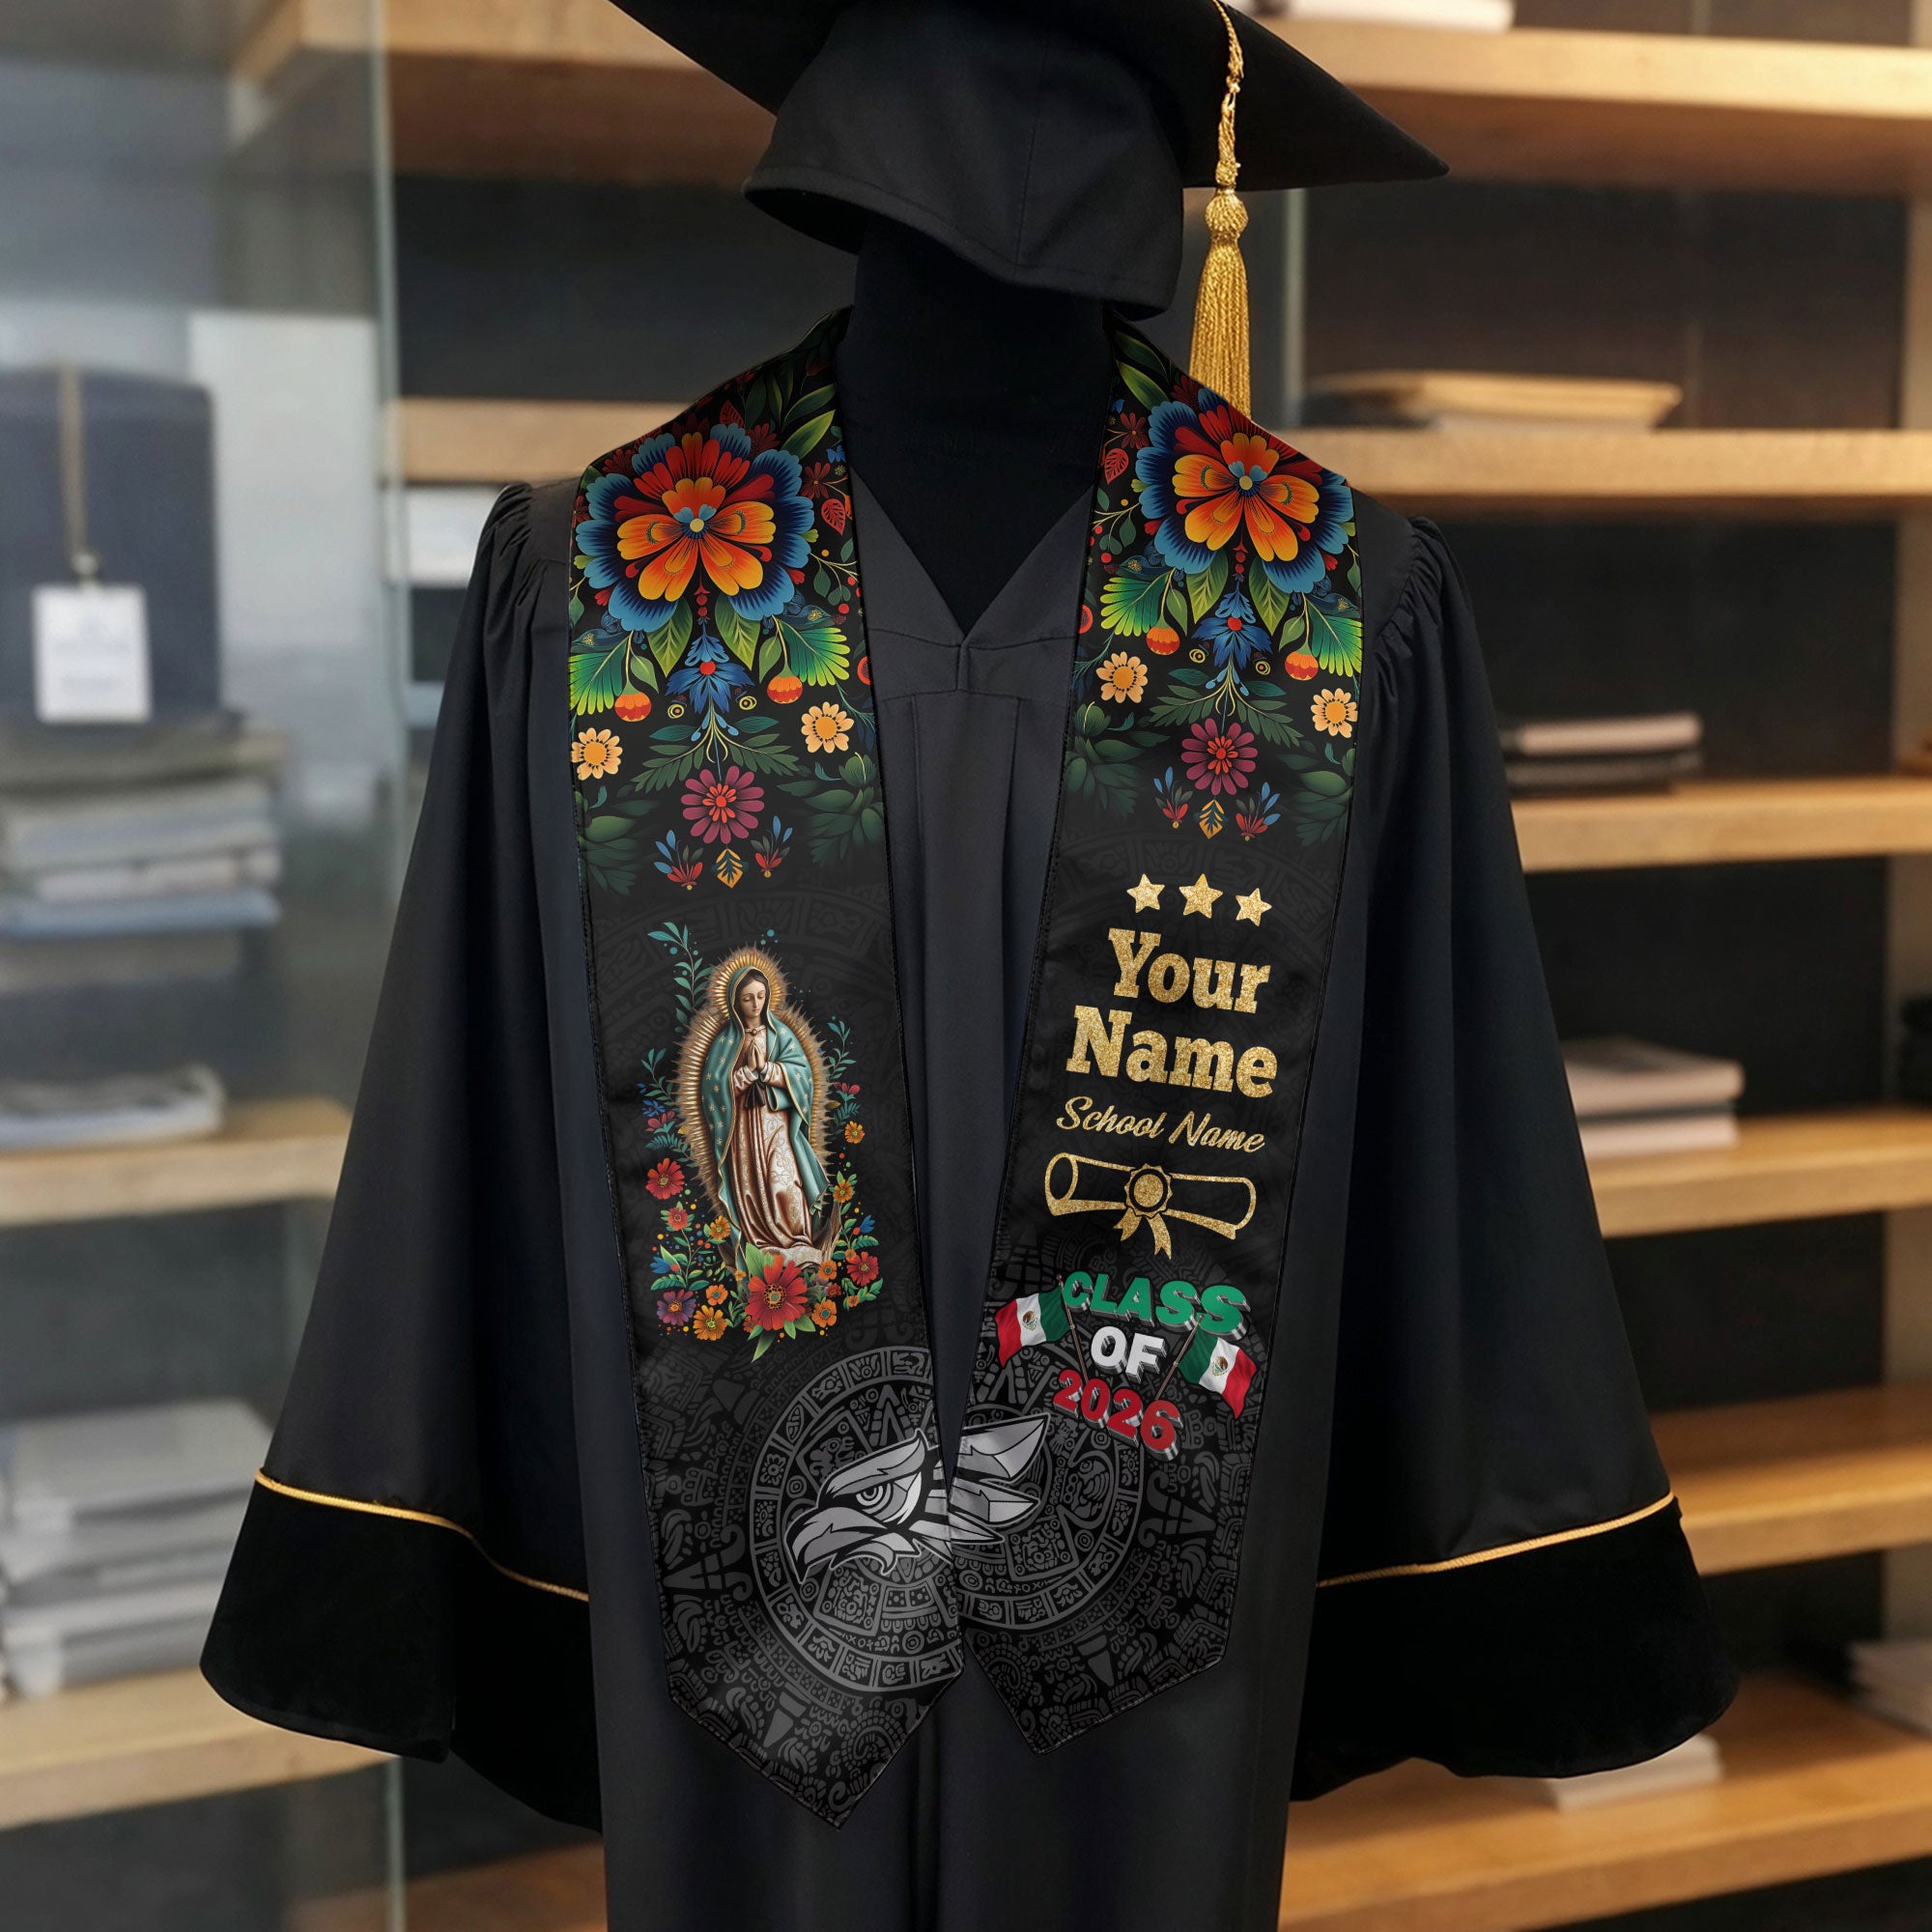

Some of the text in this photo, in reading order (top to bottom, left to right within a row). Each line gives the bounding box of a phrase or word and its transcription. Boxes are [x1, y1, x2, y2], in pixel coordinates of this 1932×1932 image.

[1108, 927, 1271, 1014] Your
[1065, 1005, 1278, 1098] Name
[1056, 1095, 1265, 1152] School Name
[1062, 1271, 1251, 1341] CLASS
[1091, 1325, 1168, 1383] OF
[1053, 1369, 1184, 1462] 2026
